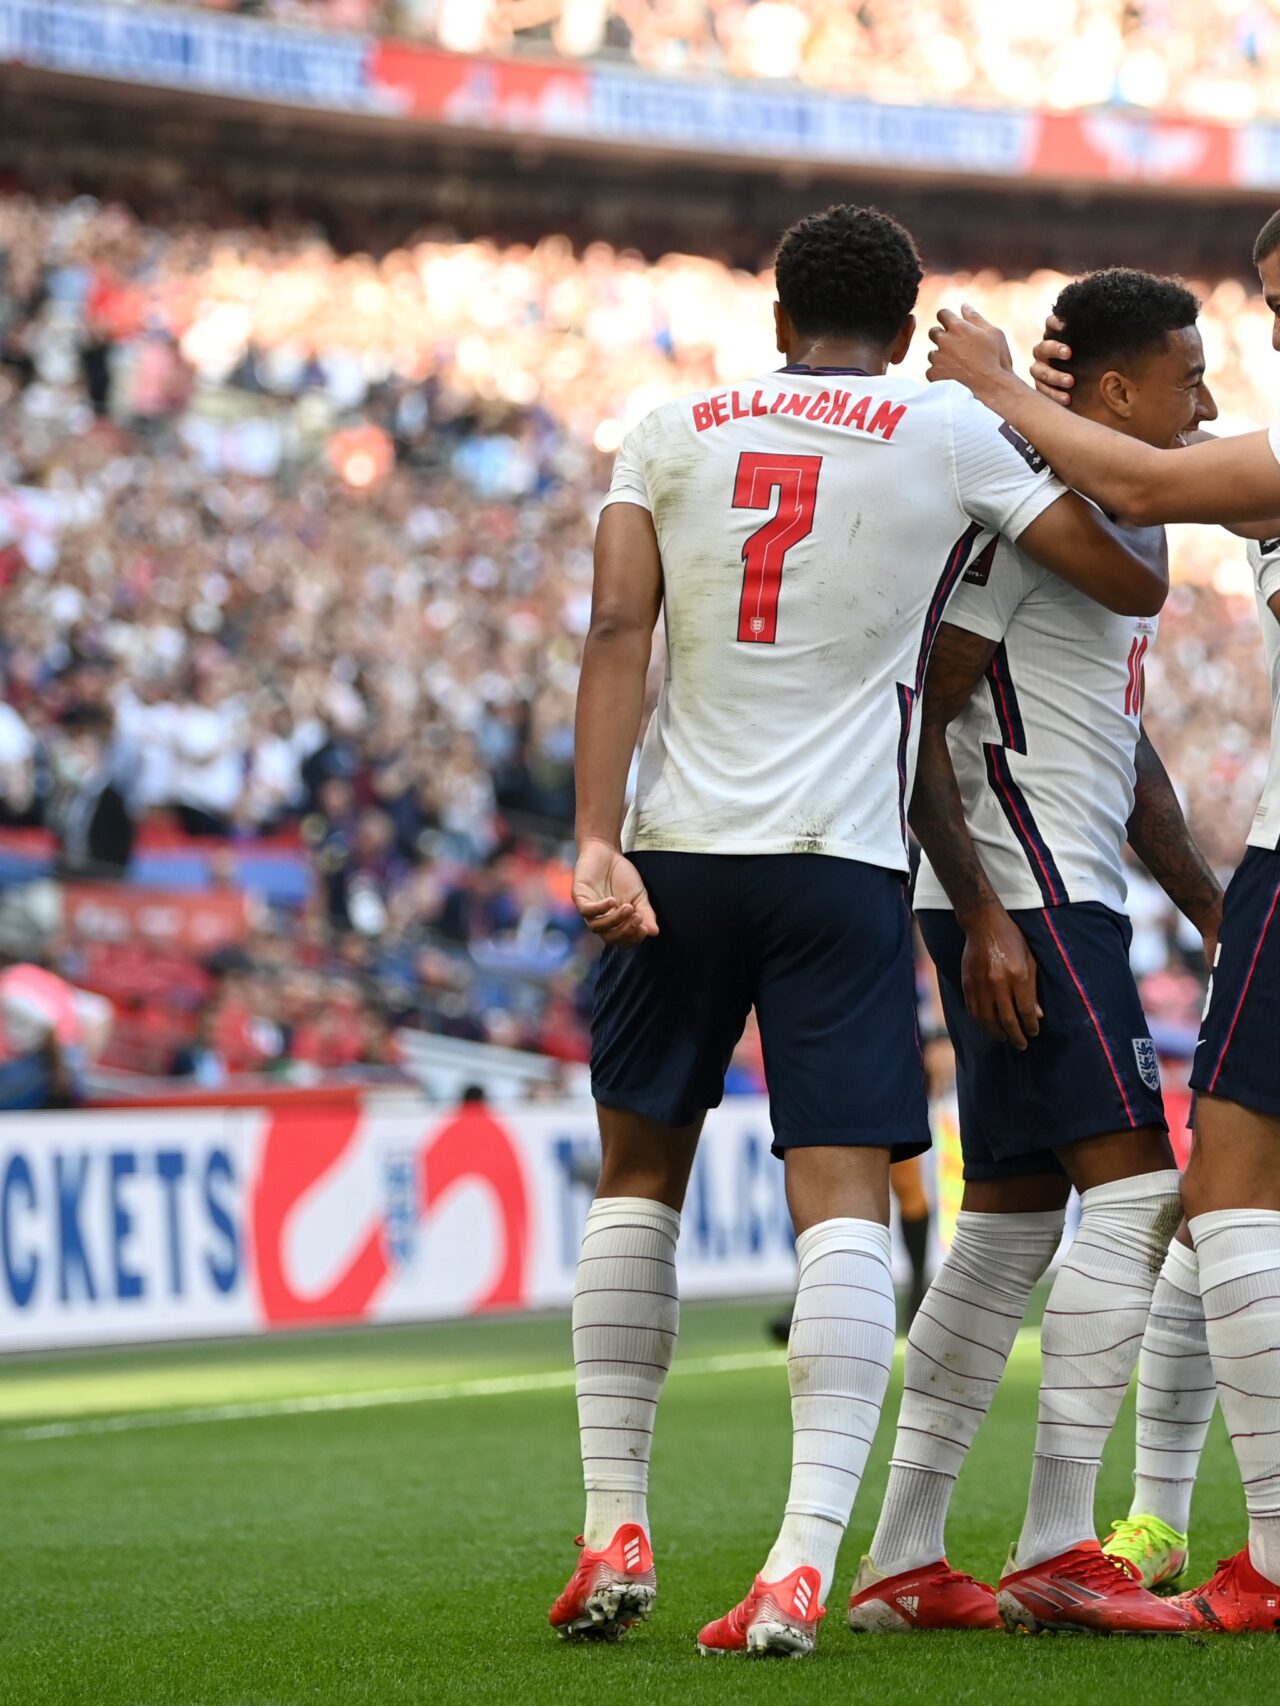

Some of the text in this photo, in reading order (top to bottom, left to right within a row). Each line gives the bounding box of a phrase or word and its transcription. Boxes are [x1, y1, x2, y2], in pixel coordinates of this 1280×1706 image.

[691, 389, 908, 441] BELLINGHAM
[731, 451, 824, 645] 7
[2, 1150, 238, 1307] CKETS
